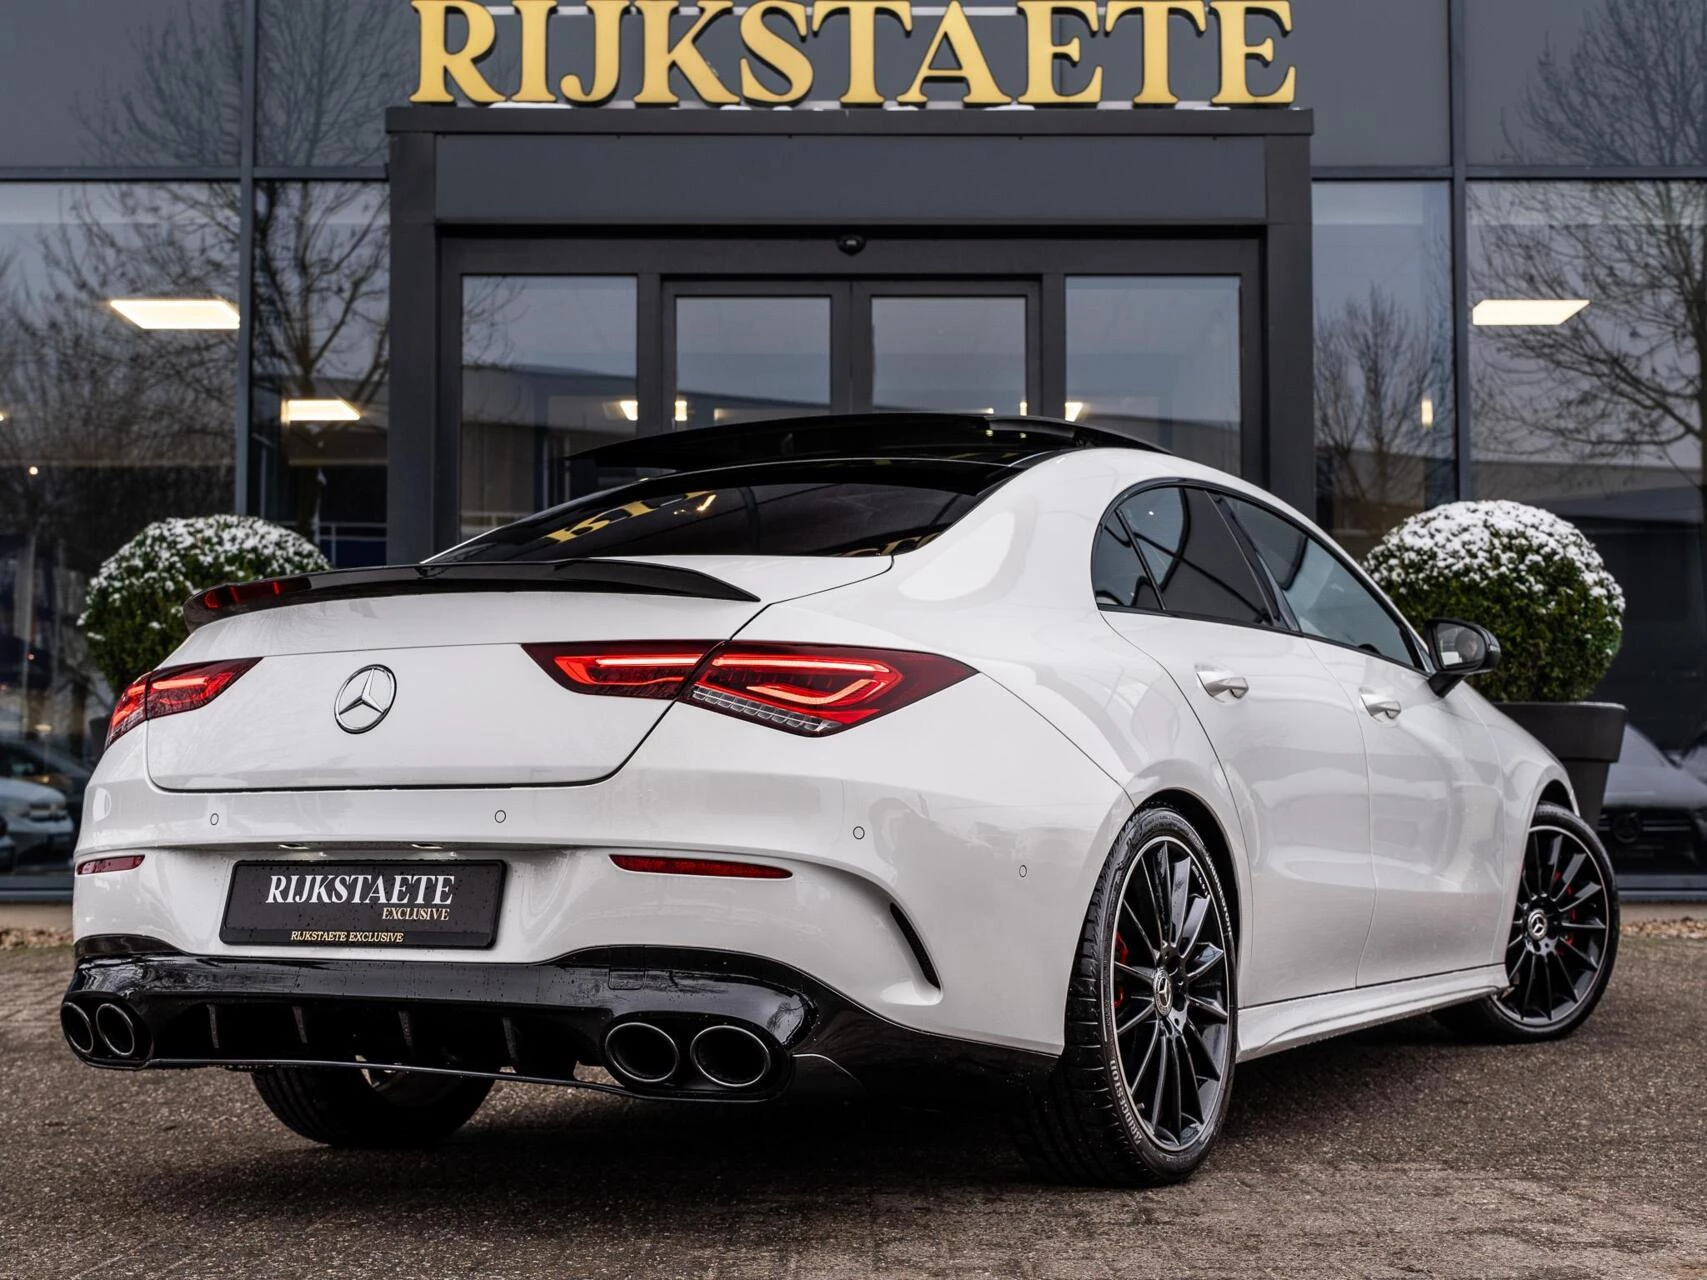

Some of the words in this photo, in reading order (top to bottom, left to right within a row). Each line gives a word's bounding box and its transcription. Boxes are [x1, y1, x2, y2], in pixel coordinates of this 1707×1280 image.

[409, 0, 1297, 105] RIJKSTAETE
[265, 874, 455, 905] RIJKSTAETE
[382, 907, 450, 921] EXCLUSIVE
[291, 931, 348, 942] RIJKSTAETE
[348, 932, 404, 943] EXCLUSIVE
[1109, 1056, 1142, 1145] BRIDGESTON
